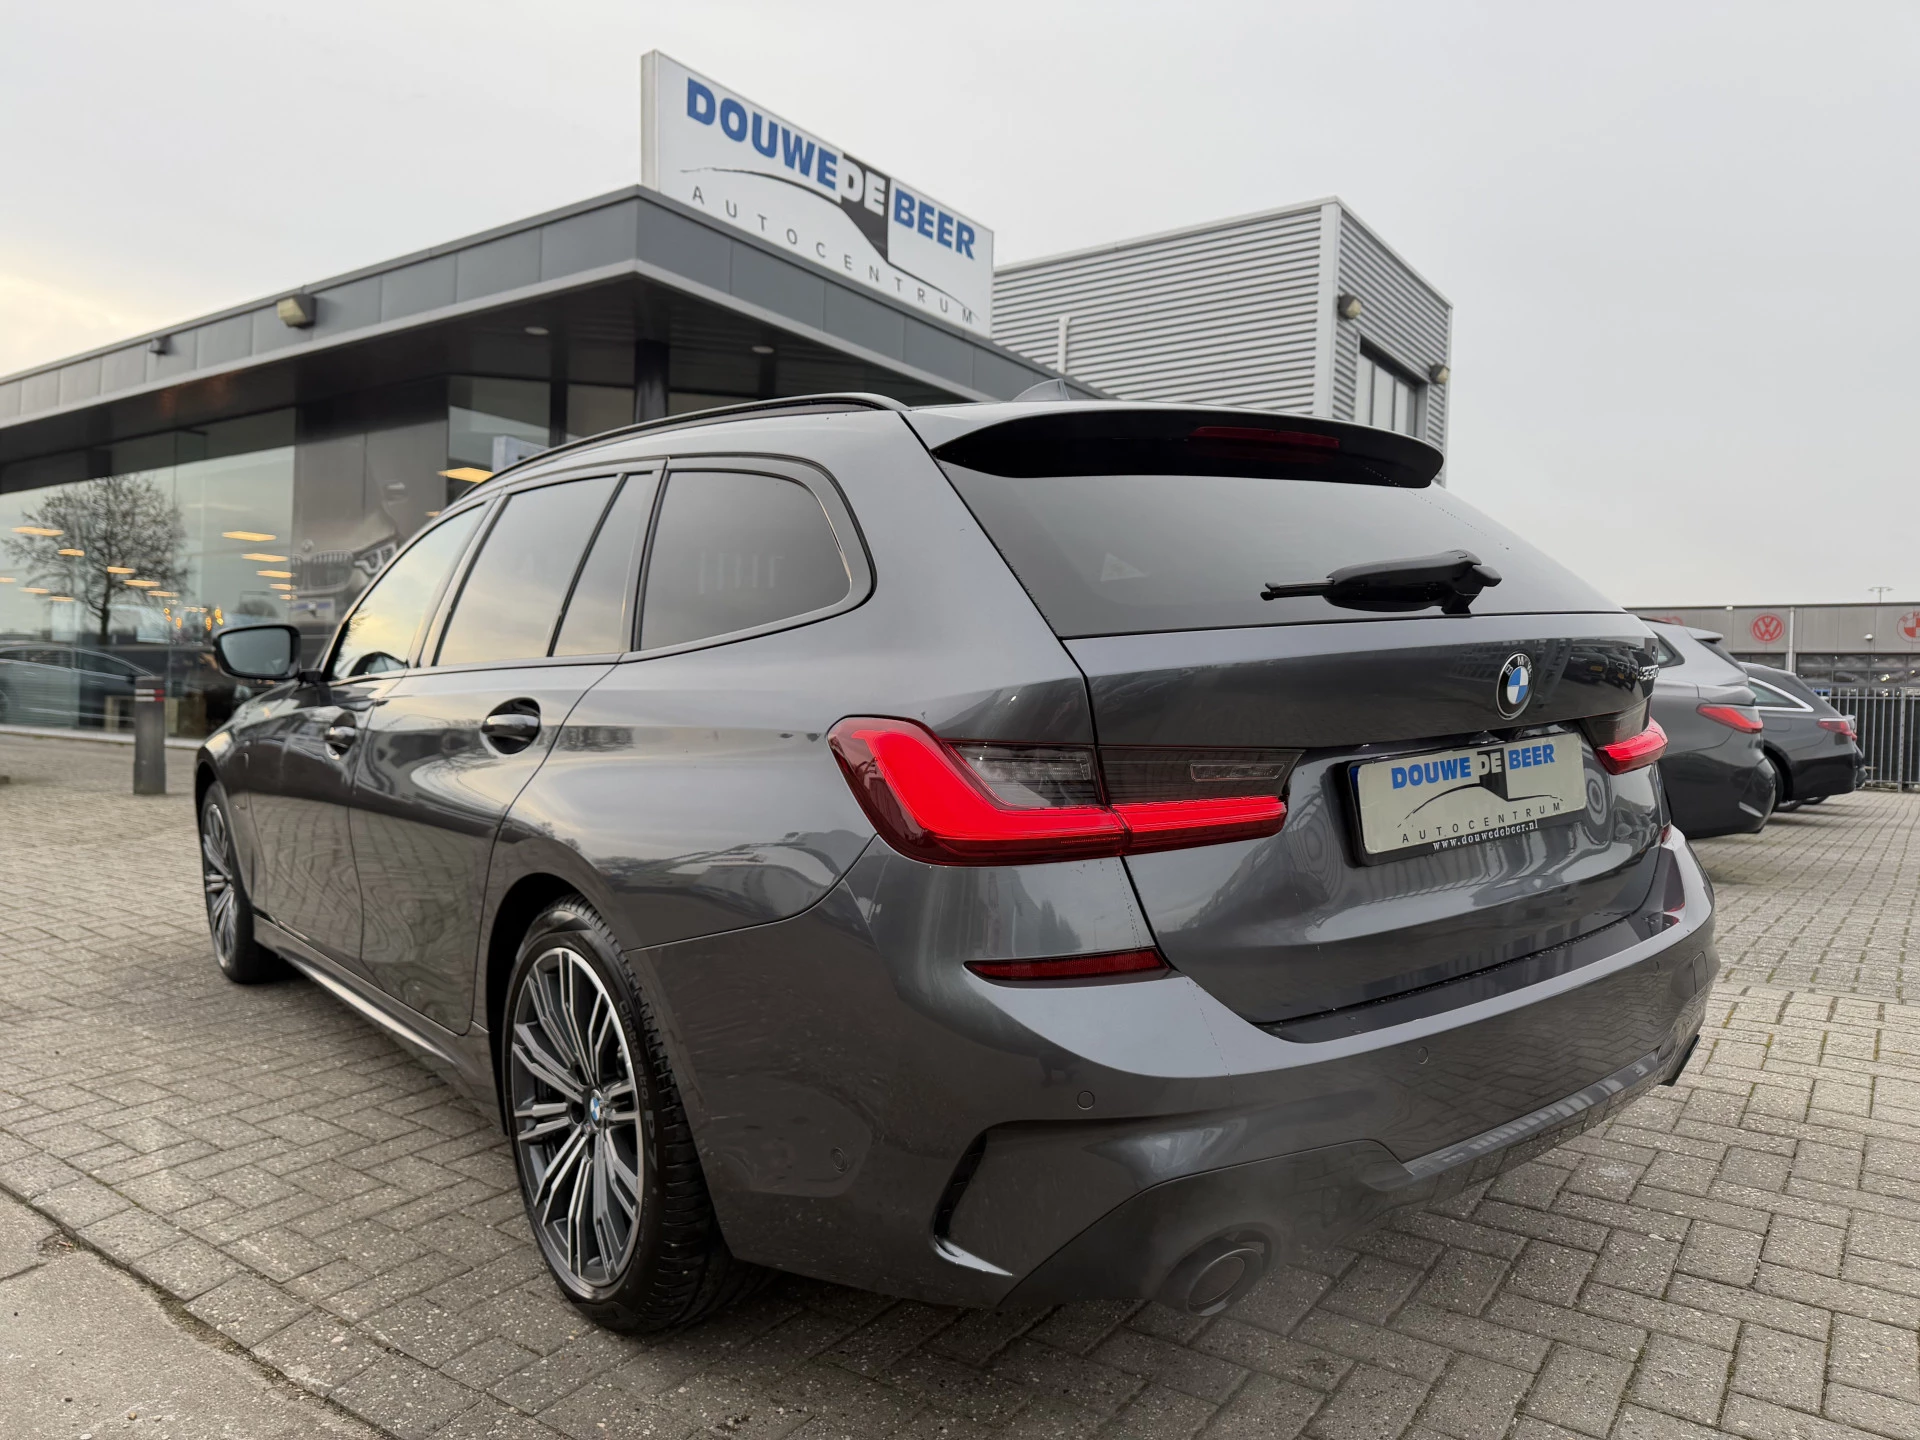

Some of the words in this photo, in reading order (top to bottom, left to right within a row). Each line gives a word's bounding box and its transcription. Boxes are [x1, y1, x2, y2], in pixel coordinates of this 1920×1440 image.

[687, 77, 838, 192] DOUWE
[838, 157, 886, 217] DE
[893, 187, 976, 260] BEER
[692, 185, 973, 324] AUTOCENTRUM
[1391, 756, 1472, 789] DOUWE
[1478, 752, 1502, 774] DE
[1508, 744, 1555, 769] BEER
[1402, 803, 1560, 843] AUTOCENTRUM
[1432, 819, 1538, 851] www.douwedebeer.nl
